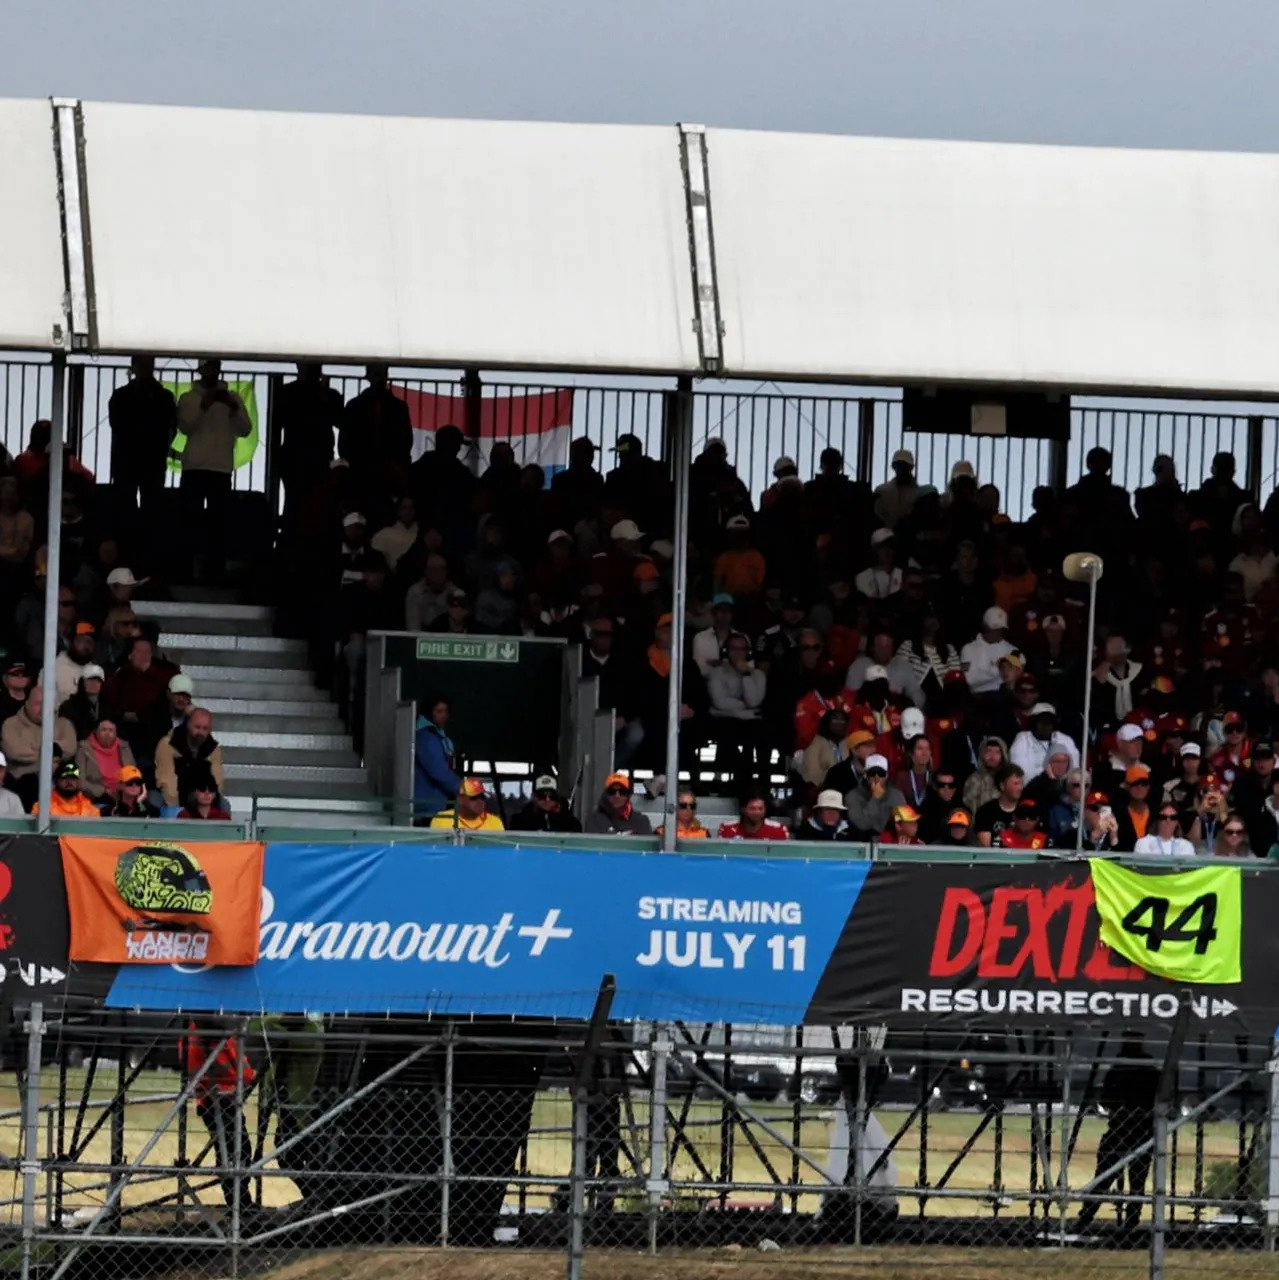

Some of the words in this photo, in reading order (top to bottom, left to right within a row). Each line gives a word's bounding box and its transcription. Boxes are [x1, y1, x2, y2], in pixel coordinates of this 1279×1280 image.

[420, 642, 449, 655] FIRE
[453, 644, 482, 656] EXIT
[638, 897, 801, 924] STREAMING
[1122, 892, 1217, 955] 44
[126, 932, 209, 945] LANDO
[637, 931, 756, 969] JULY
[767, 936, 805, 971] 11
